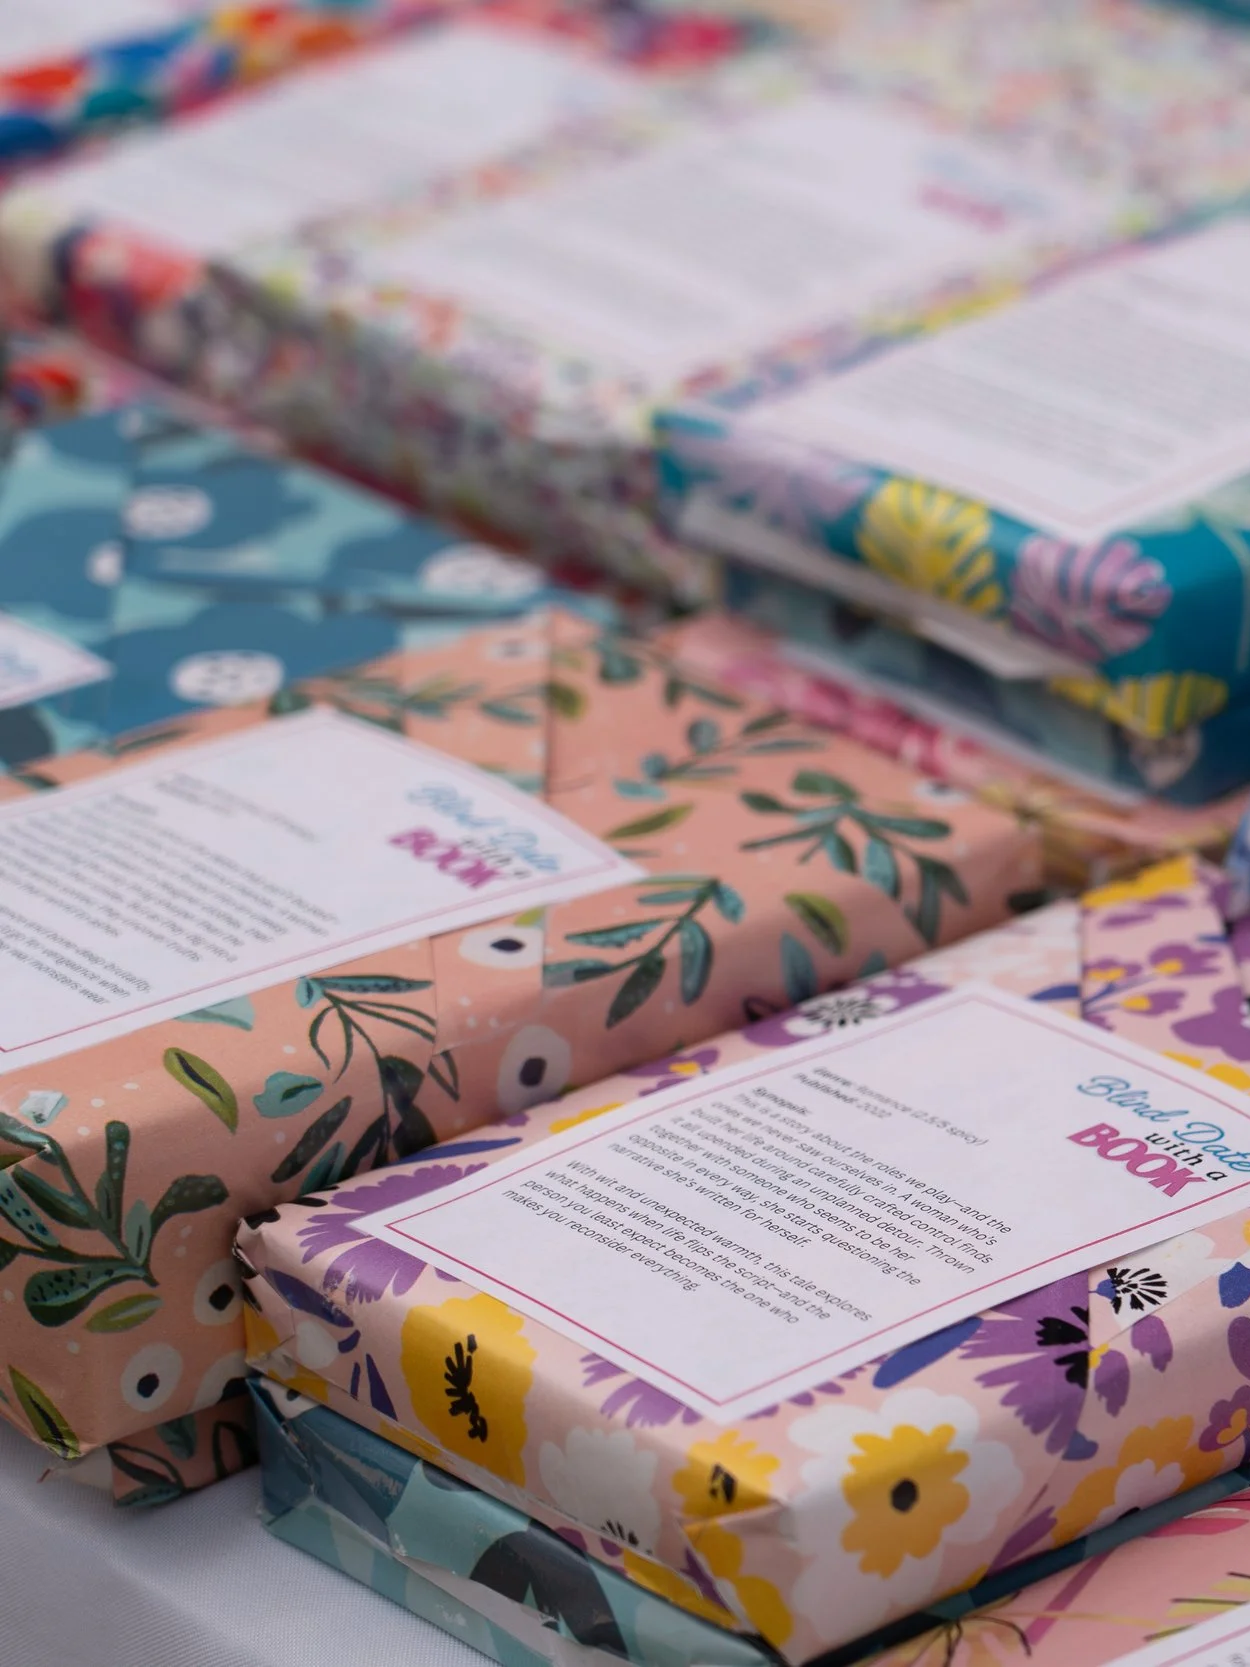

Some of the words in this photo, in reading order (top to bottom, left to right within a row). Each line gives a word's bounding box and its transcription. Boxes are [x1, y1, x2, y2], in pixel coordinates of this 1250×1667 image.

[387, 826, 502, 890] BOOK
[1066, 1122, 1207, 1197] BOOK
[1077, 1075, 1189, 1122] Blind
[1145, 1132, 1204, 1167] with
[1206, 1171, 1228, 1181] a
[608, 1143, 665, 1172] narrative
[661, 1169, 698, 1188] she's
[695, 1185, 742, 1212] written
[739, 1208, 764, 1222] for
[759, 1218, 812, 1248] herself.
[628, 1134, 685, 1162] opposite
[681, 1158, 698, 1170] in
[695, 1167, 734, 1187] every
[730, 1184, 760, 1204] way,
[759, 1200, 786, 1215] she
[783, 1212, 824, 1235] starts
[821, 1233, 900, 1275] questioning
[895, 1270, 921, 1286] the
[649, 1124, 706, 1153] together
[701, 1150, 732, 1168] with
[728, 1165, 788, 1196] someone
[785, 1193, 816, 1210] who
[813, 1208, 857, 1232] seems
[854, 1229, 872, 1240] to
[869, 1237, 891, 1250] be
[888, 1246, 916, 1261] her
[696, 1130, 758, 1160] upended
[751, 1157, 797, 1182] during
[791, 1178, 812, 1189] an
[809, 1186, 882, 1224] unplanned
[876, 1221, 924, 1248] detour.
[925, 1244, 975, 1274] Thrown
[719, 1122, 745, 1136] her
[740, 1132, 765, 1147] life
[762, 1144, 814, 1169] around
[807, 1167, 866, 1197] carefully
[862, 1194, 916, 1221] crafted
[910, 1219, 963, 1246] control
[957, 1242, 994, 1264] finds
[759, 1124, 800, 1144] never
[795, 1143, 824, 1157] saw
[821, 1156, 884, 1187] ourselves
[880, 1183, 898, 1196] in.
[897, 1193, 913, 1202] A
[910, 1199, 959, 1226] woman
[956, 1223, 998, 1246] who's
[777, 1116, 815, 1135] story
[811, 1132, 853, 1153] about
[846, 1150, 874, 1164] the
[871, 1161, 907, 1180] roles
[986, 1218, 1012, 1234] the
[502, 1190, 544, 1211] makes
[535, 1208, 568, 1223] you
[564, 1220, 634, 1254] reconsider
[630, 1252, 701, 1292] everything.
[519, 1180, 569, 1204] person
[561, 1200, 593, 1215] you
[589, 1211, 625, 1231] least
[620, 1228, 667, 1252] expect
[663, 1248, 723, 1282] becomes
[720, 1279, 746, 1295] the
[743, 1292, 771, 1308] one
[769, 1306, 800, 1324] who
[544, 1170, 579, 1188] what
[575, 1183, 631, 1213] happens
[627, 1210, 664, 1231] when
[661, 1227, 686, 1242] life
[683, 1239, 715, 1257] flips
[711, 1254, 737, 1269] the
[804, 1304, 831, 1320] the
[566, 1160, 598, 1178] With
[595, 1174, 618, 1187] wit
[614, 1185, 646, 1199] and
[639, 1197, 718, 1237] unexpected
[711, 1234, 762, 1266] warmth,
[763, 1262, 792, 1278] this
[788, 1275, 817, 1292] tale
[814, 1289, 873, 1322] explores
